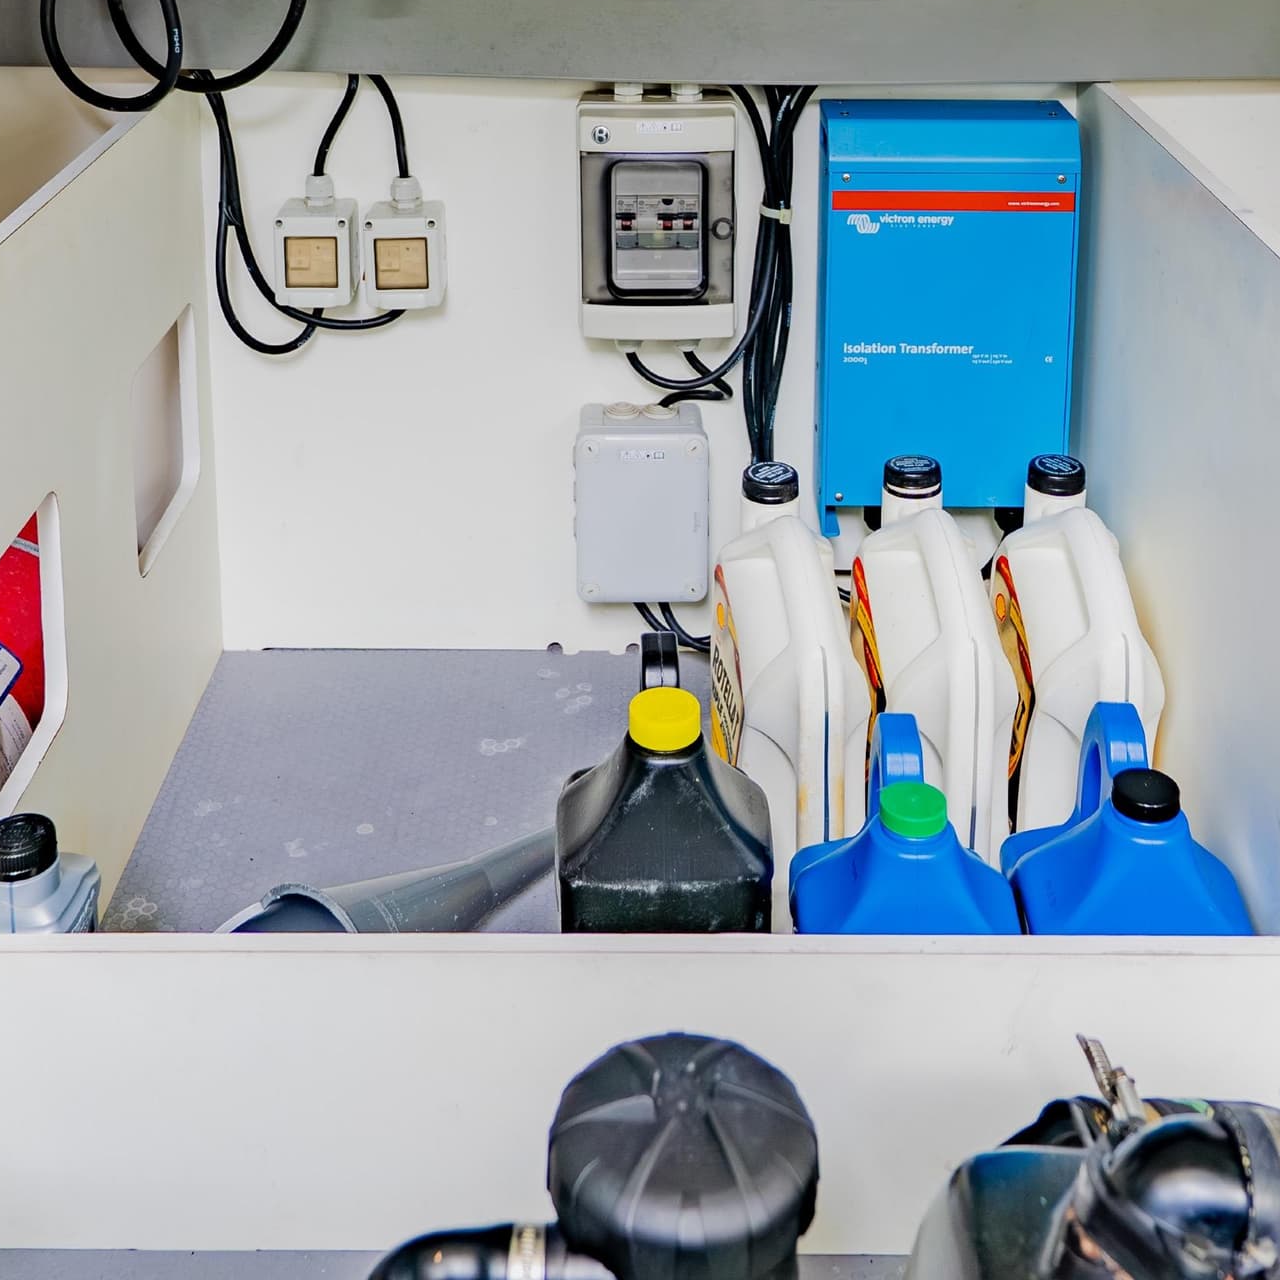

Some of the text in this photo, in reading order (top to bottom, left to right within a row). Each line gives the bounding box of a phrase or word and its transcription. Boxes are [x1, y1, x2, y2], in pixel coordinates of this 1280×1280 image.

[879, 213, 955, 226] victron energy
[843, 342, 974, 354] Isolation Transformer
